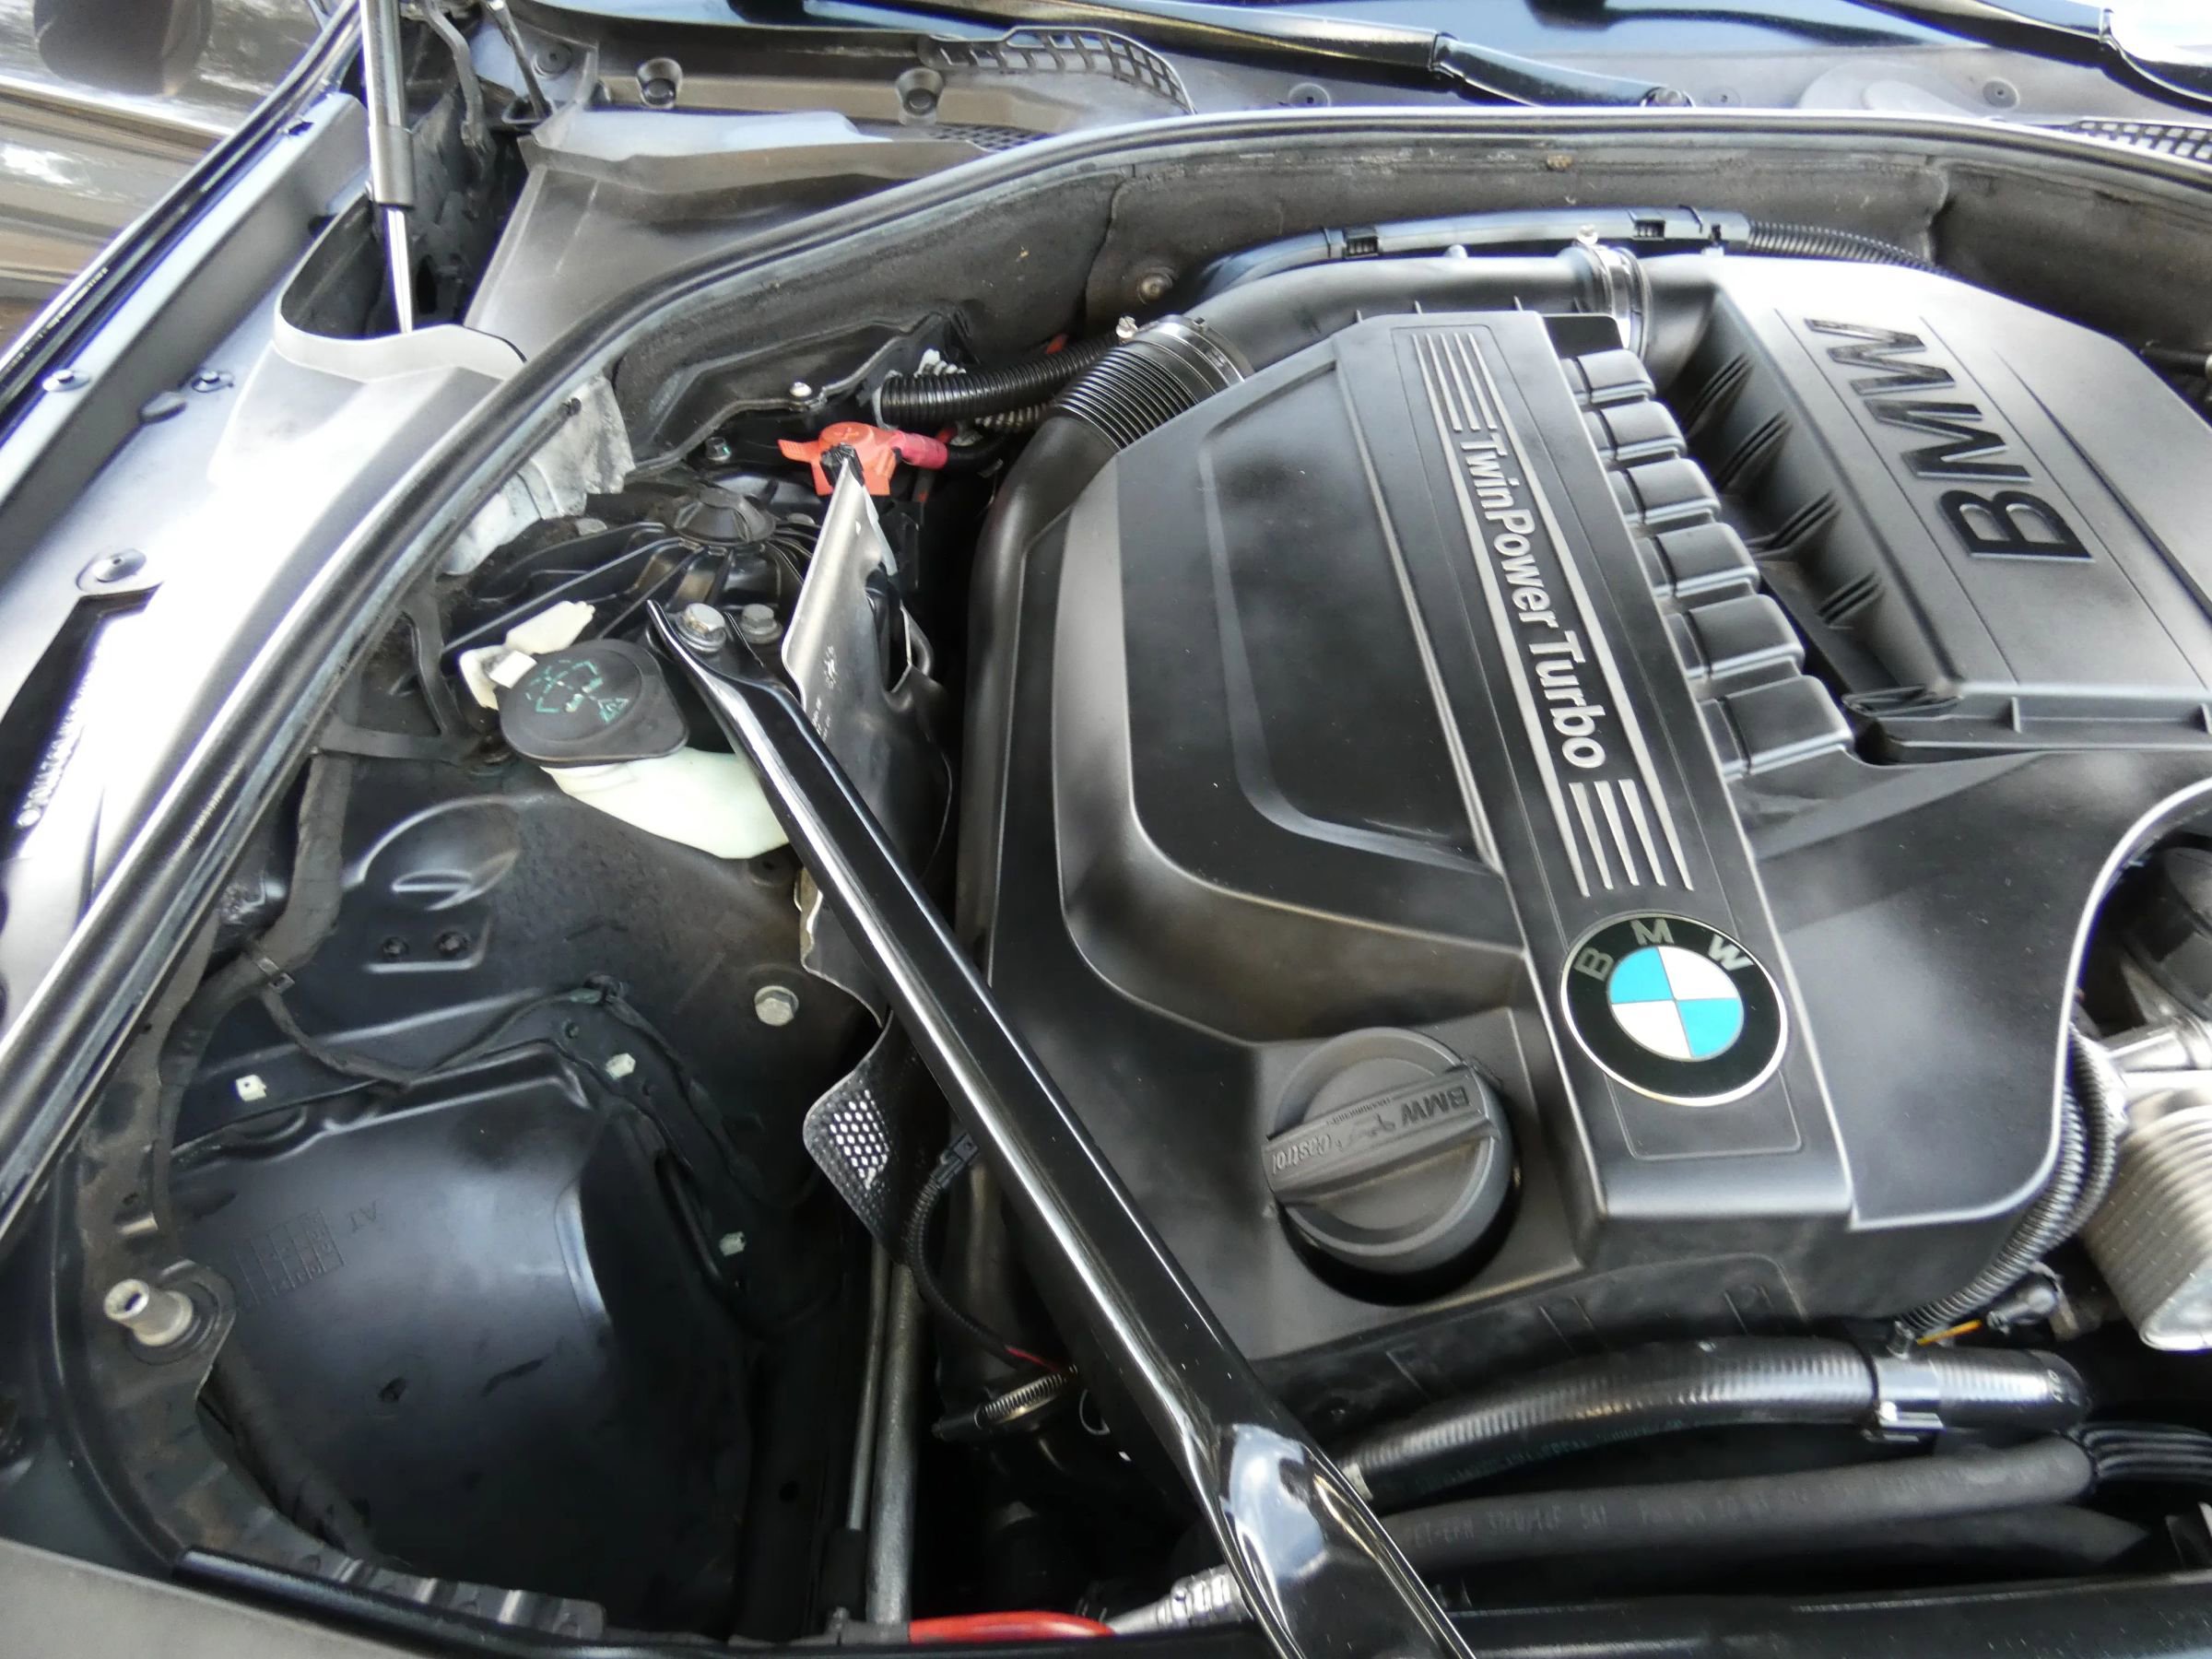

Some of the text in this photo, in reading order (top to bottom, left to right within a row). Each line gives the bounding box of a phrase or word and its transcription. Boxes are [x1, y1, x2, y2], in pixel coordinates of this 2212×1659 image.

[1805, 319, 2094, 562] BMW
[1461, 429, 1606, 769] TwinPower Turbo
[1573, 918, 1754, 982] BMW
[1401, 1086, 1470, 1127] BMW
